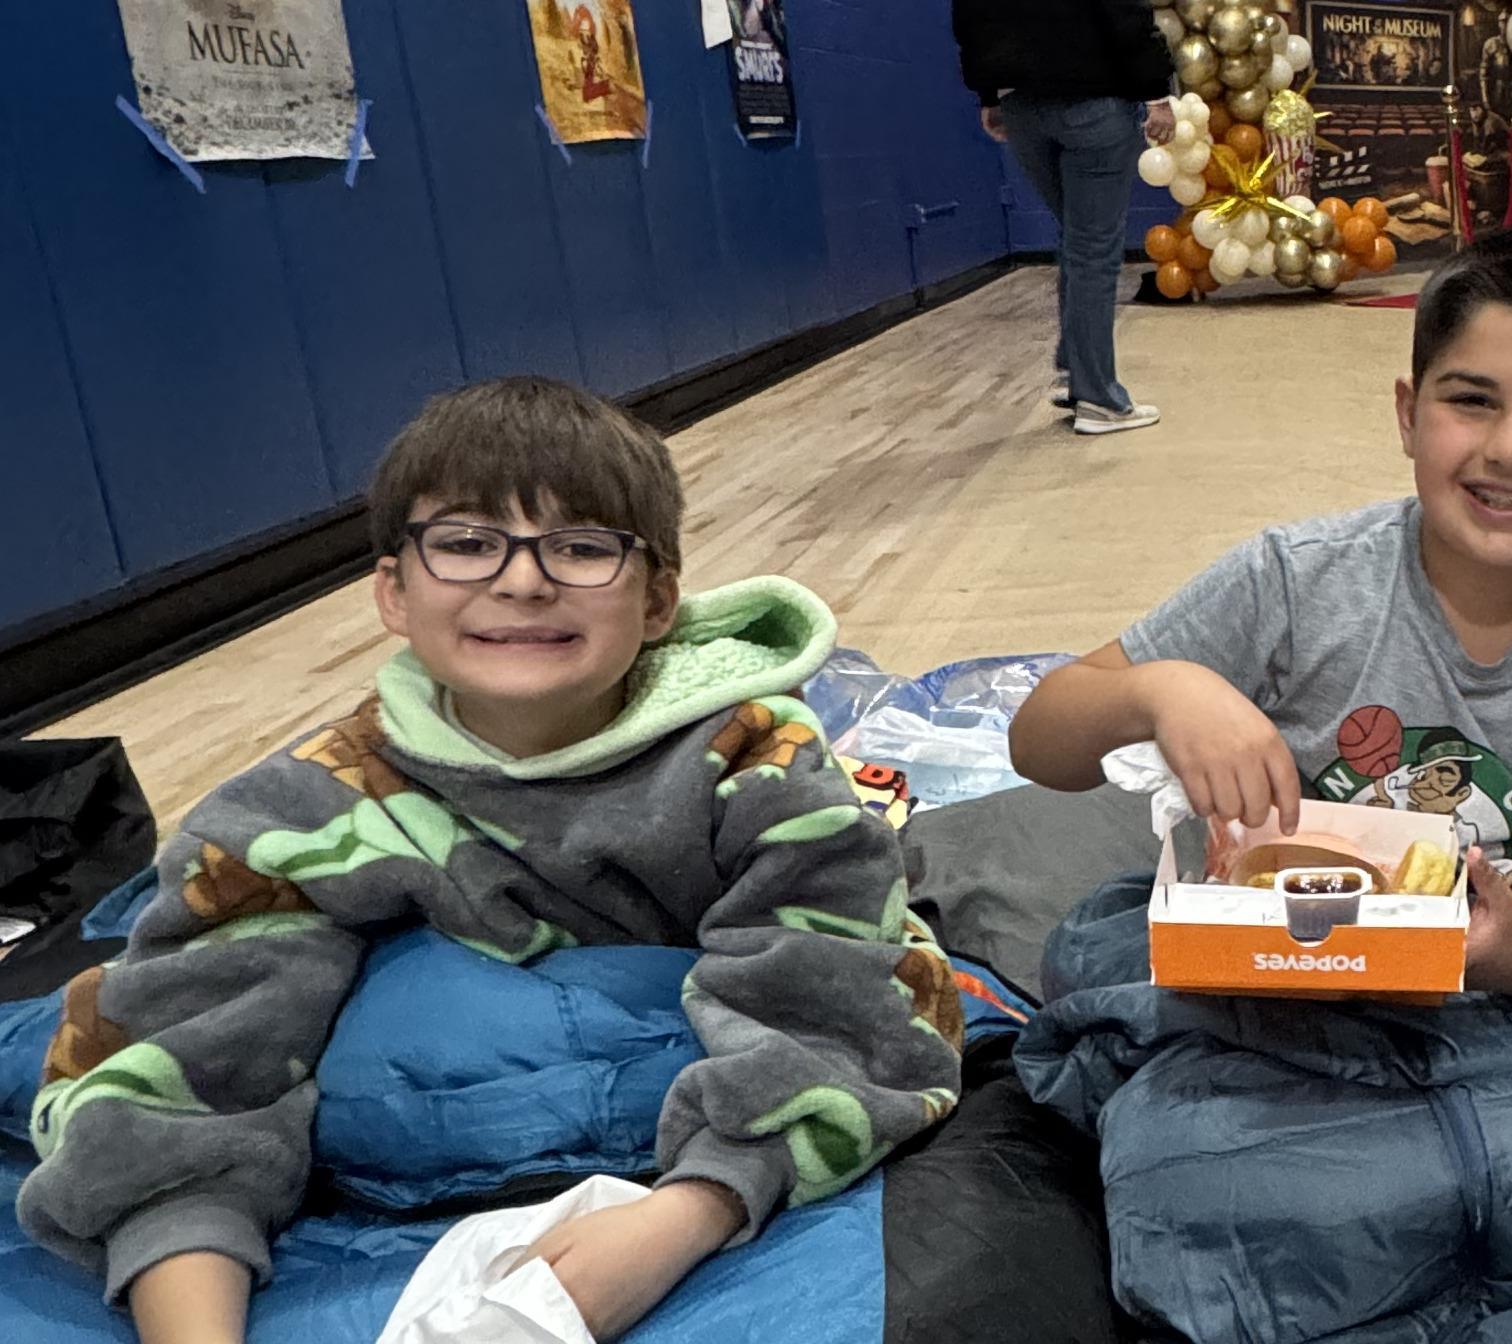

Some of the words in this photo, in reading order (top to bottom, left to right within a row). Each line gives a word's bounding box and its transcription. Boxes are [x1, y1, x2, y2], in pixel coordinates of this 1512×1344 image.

[186, 19, 306, 70] MUFASA
[1322, 13, 1373, 35] NIGHT
[1384, 17, 1442, 39] MUSEUM
